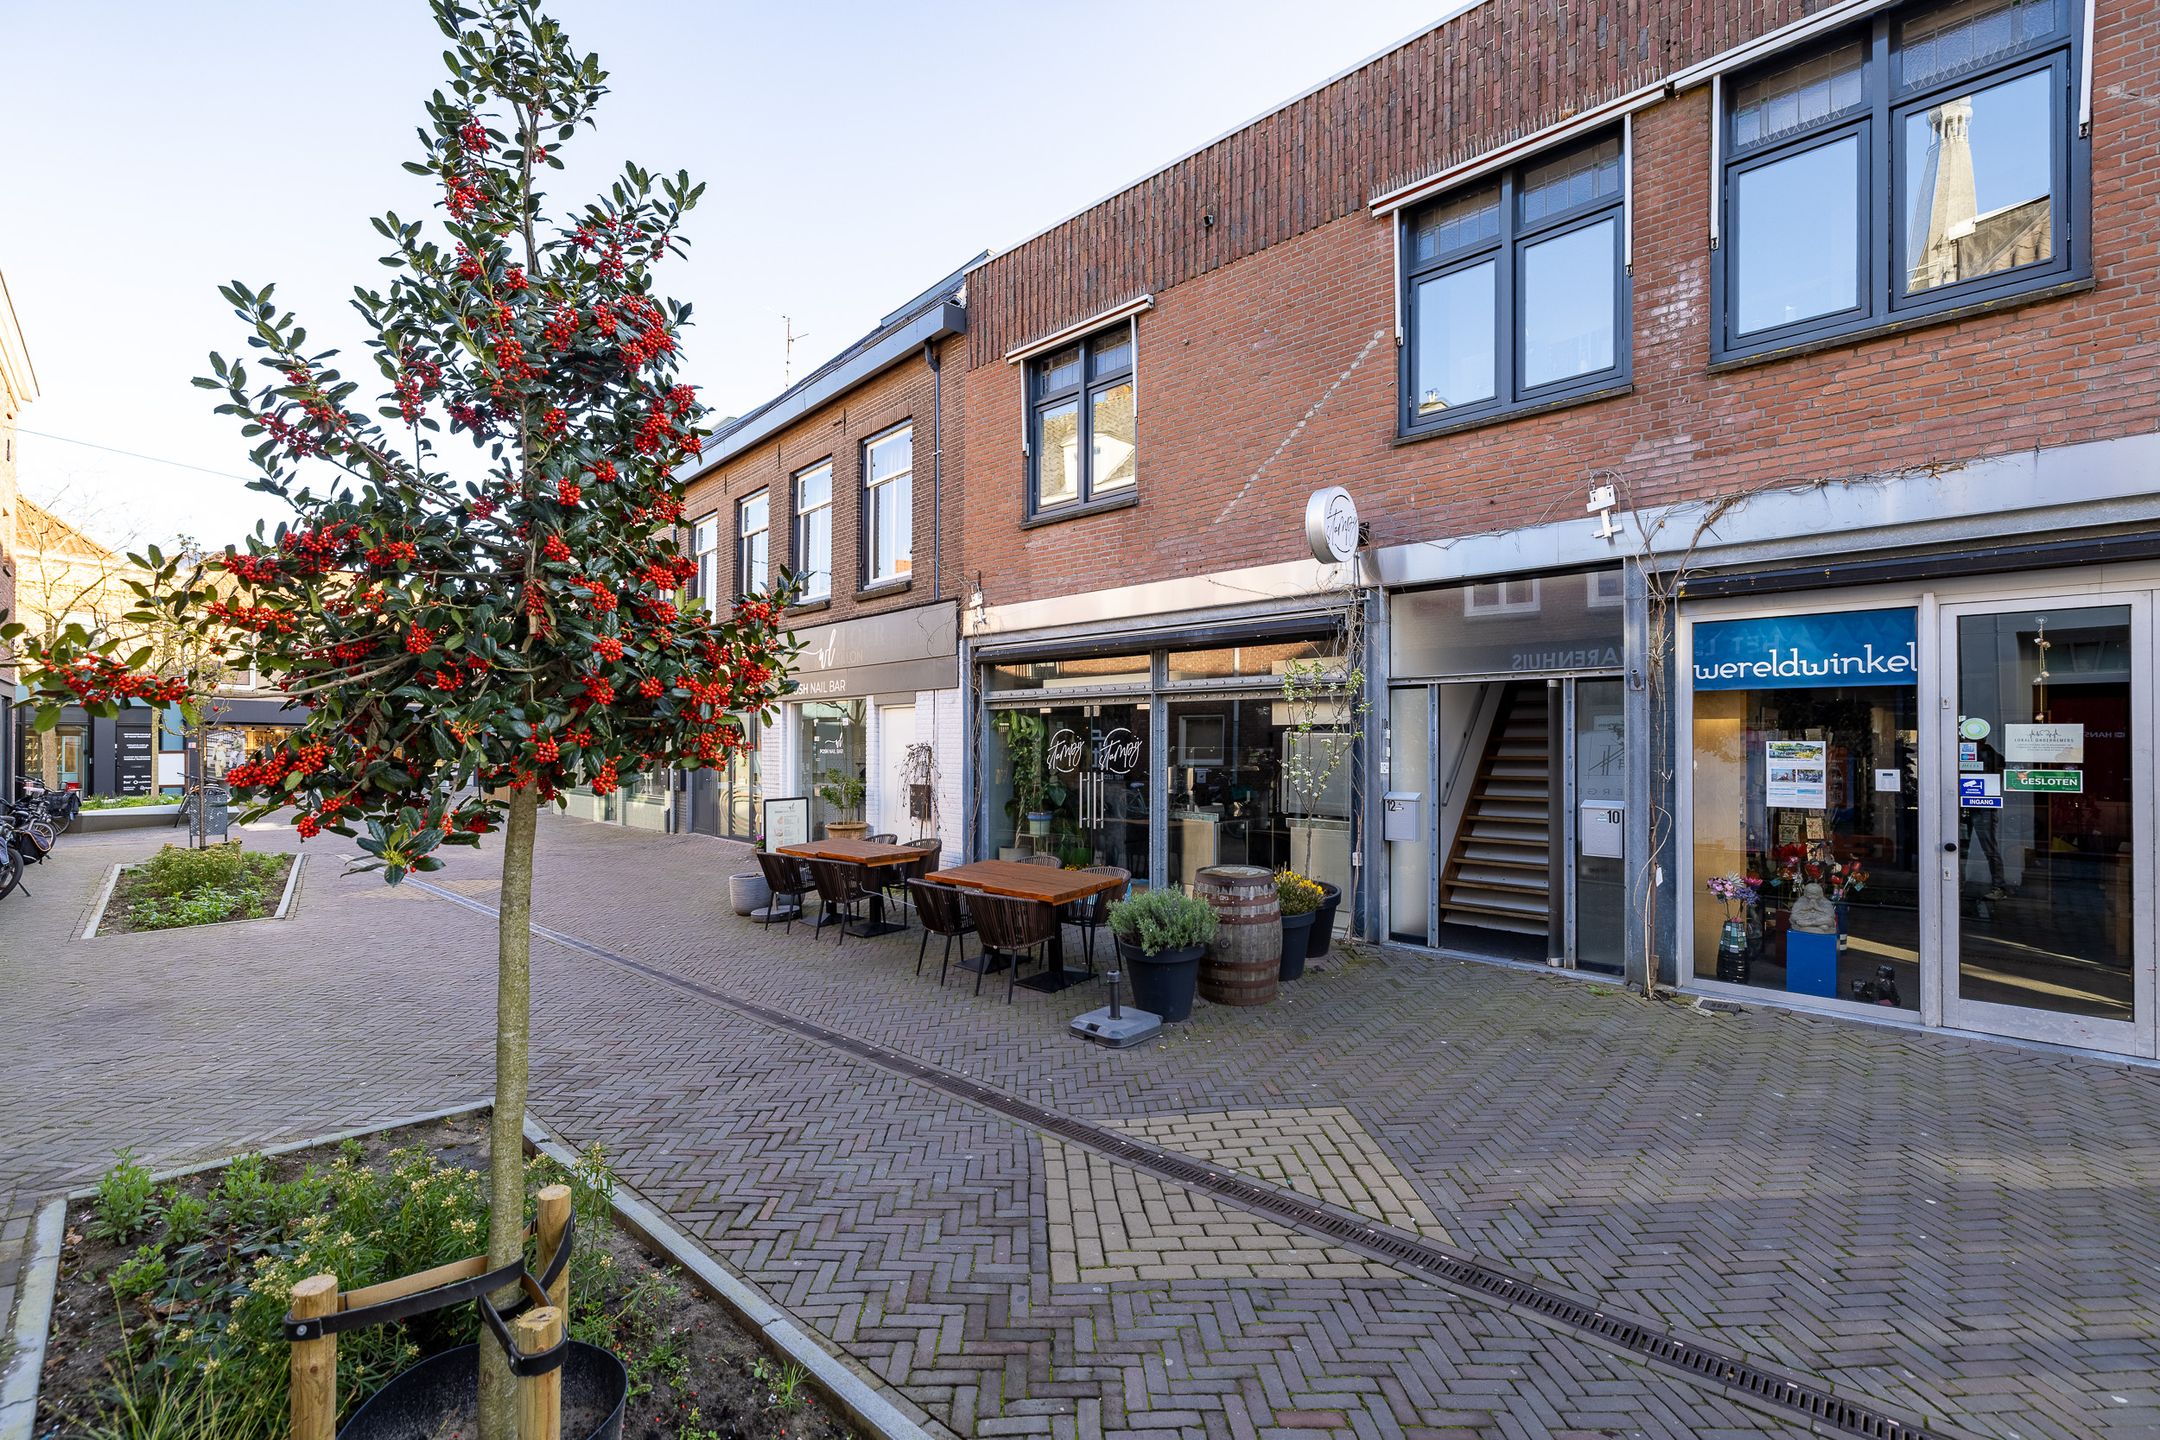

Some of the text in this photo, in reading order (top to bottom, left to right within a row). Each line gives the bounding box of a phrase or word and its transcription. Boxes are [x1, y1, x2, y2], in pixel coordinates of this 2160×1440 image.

[1693, 641, 1918, 680] wereldwinkel
[810, 681, 828, 694] NAIL
[829, 679, 846, 693] BAR
[2020, 778, 2078, 786] GESLOTEN
[1387, 800, 1396, 811] 12
[1607, 810, 1620, 824] 10
